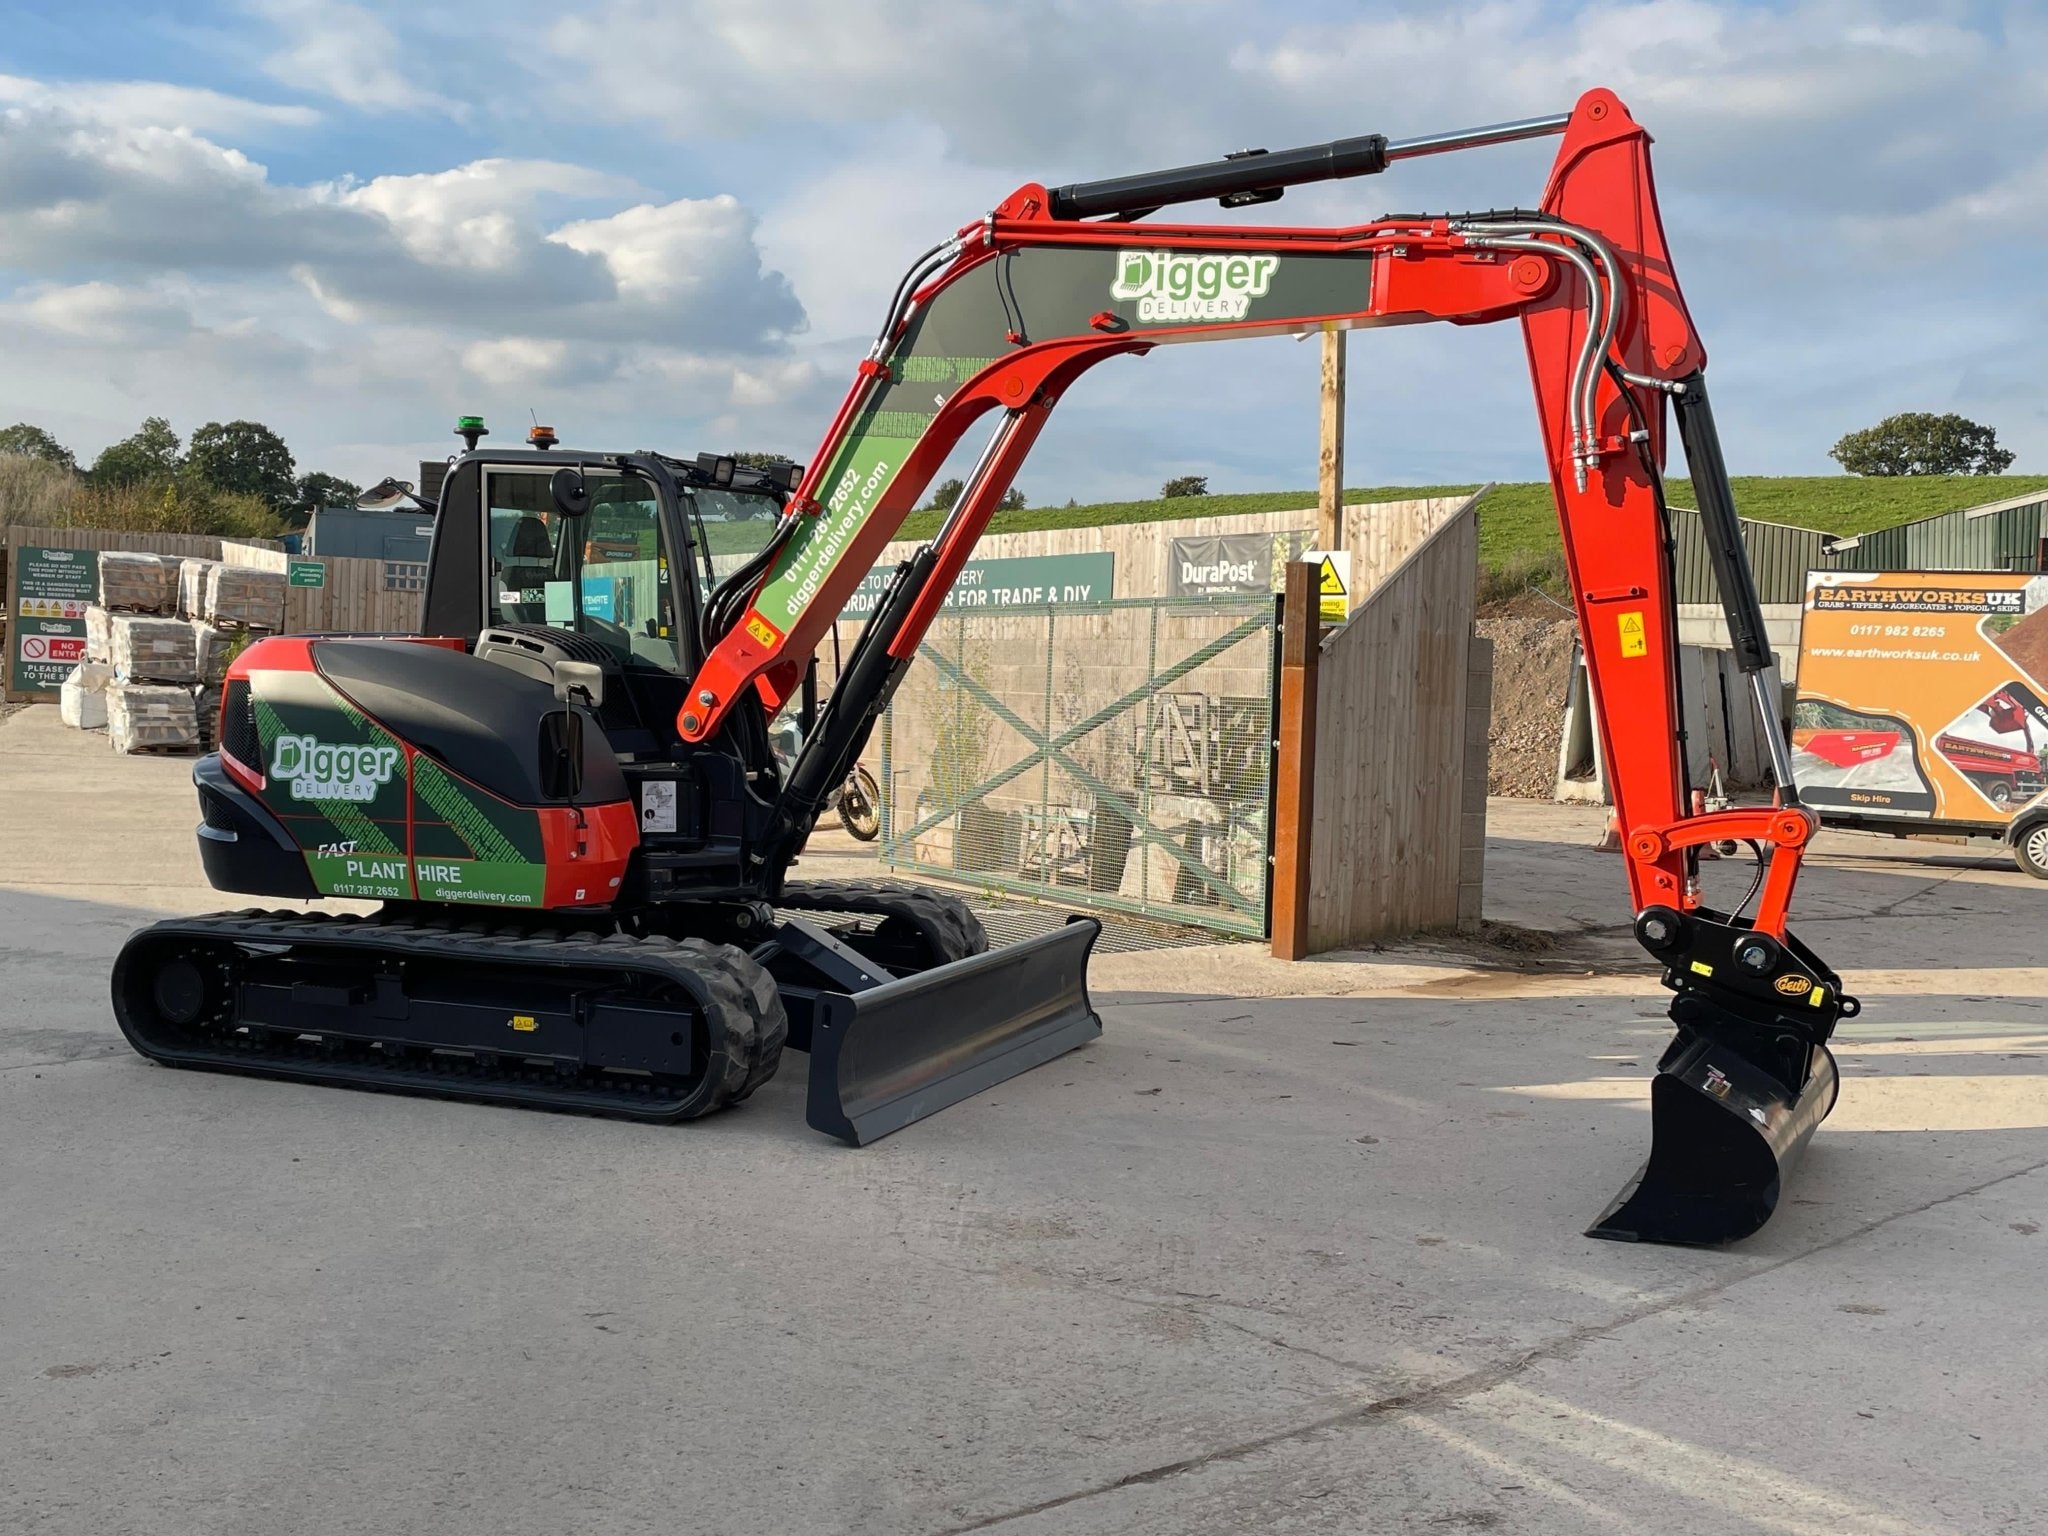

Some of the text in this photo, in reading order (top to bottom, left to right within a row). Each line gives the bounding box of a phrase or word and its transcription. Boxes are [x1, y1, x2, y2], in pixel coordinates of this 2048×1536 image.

[1120, 253, 1271, 301] Digger
[1144, 299, 1243, 314] DELIVERY
[784, 468, 861, 583] 0117 287 2652
[786, 461, 889, 616] diggerdelivery.com
[1182, 560, 1255, 583] DuraPost
[868, 575, 881, 589] TO
[959, 589, 986, 606] FOR
[992, 586, 1042, 605] TRADE
[1048, 585, 1058, 602] &
[1063, 585, 1091, 602] DIY
[1890, 602, 1947, 611] AGGREGATES
[1850, 624, 1945, 638] 0117 982 8265
[61, 642, 74, 650] NO
[1811, 646, 1981, 662] www.earthworksuk.co.uk
[23, 671, 36, 679] TO
[38, 672, 56, 680] THE
[27, 664, 64, 673] PLEASE
[277, 740, 393, 783] Digger
[295, 783, 373, 795] DELIVERY
[1850, 793, 1892, 804] Skip Hire
[317, 840, 357, 859] FAST
[346, 861, 462, 883] PLANT HIRE
[333, 883, 399, 897] 0117 287 2652
[435, 888, 532, 903] diggerdelivery.com
